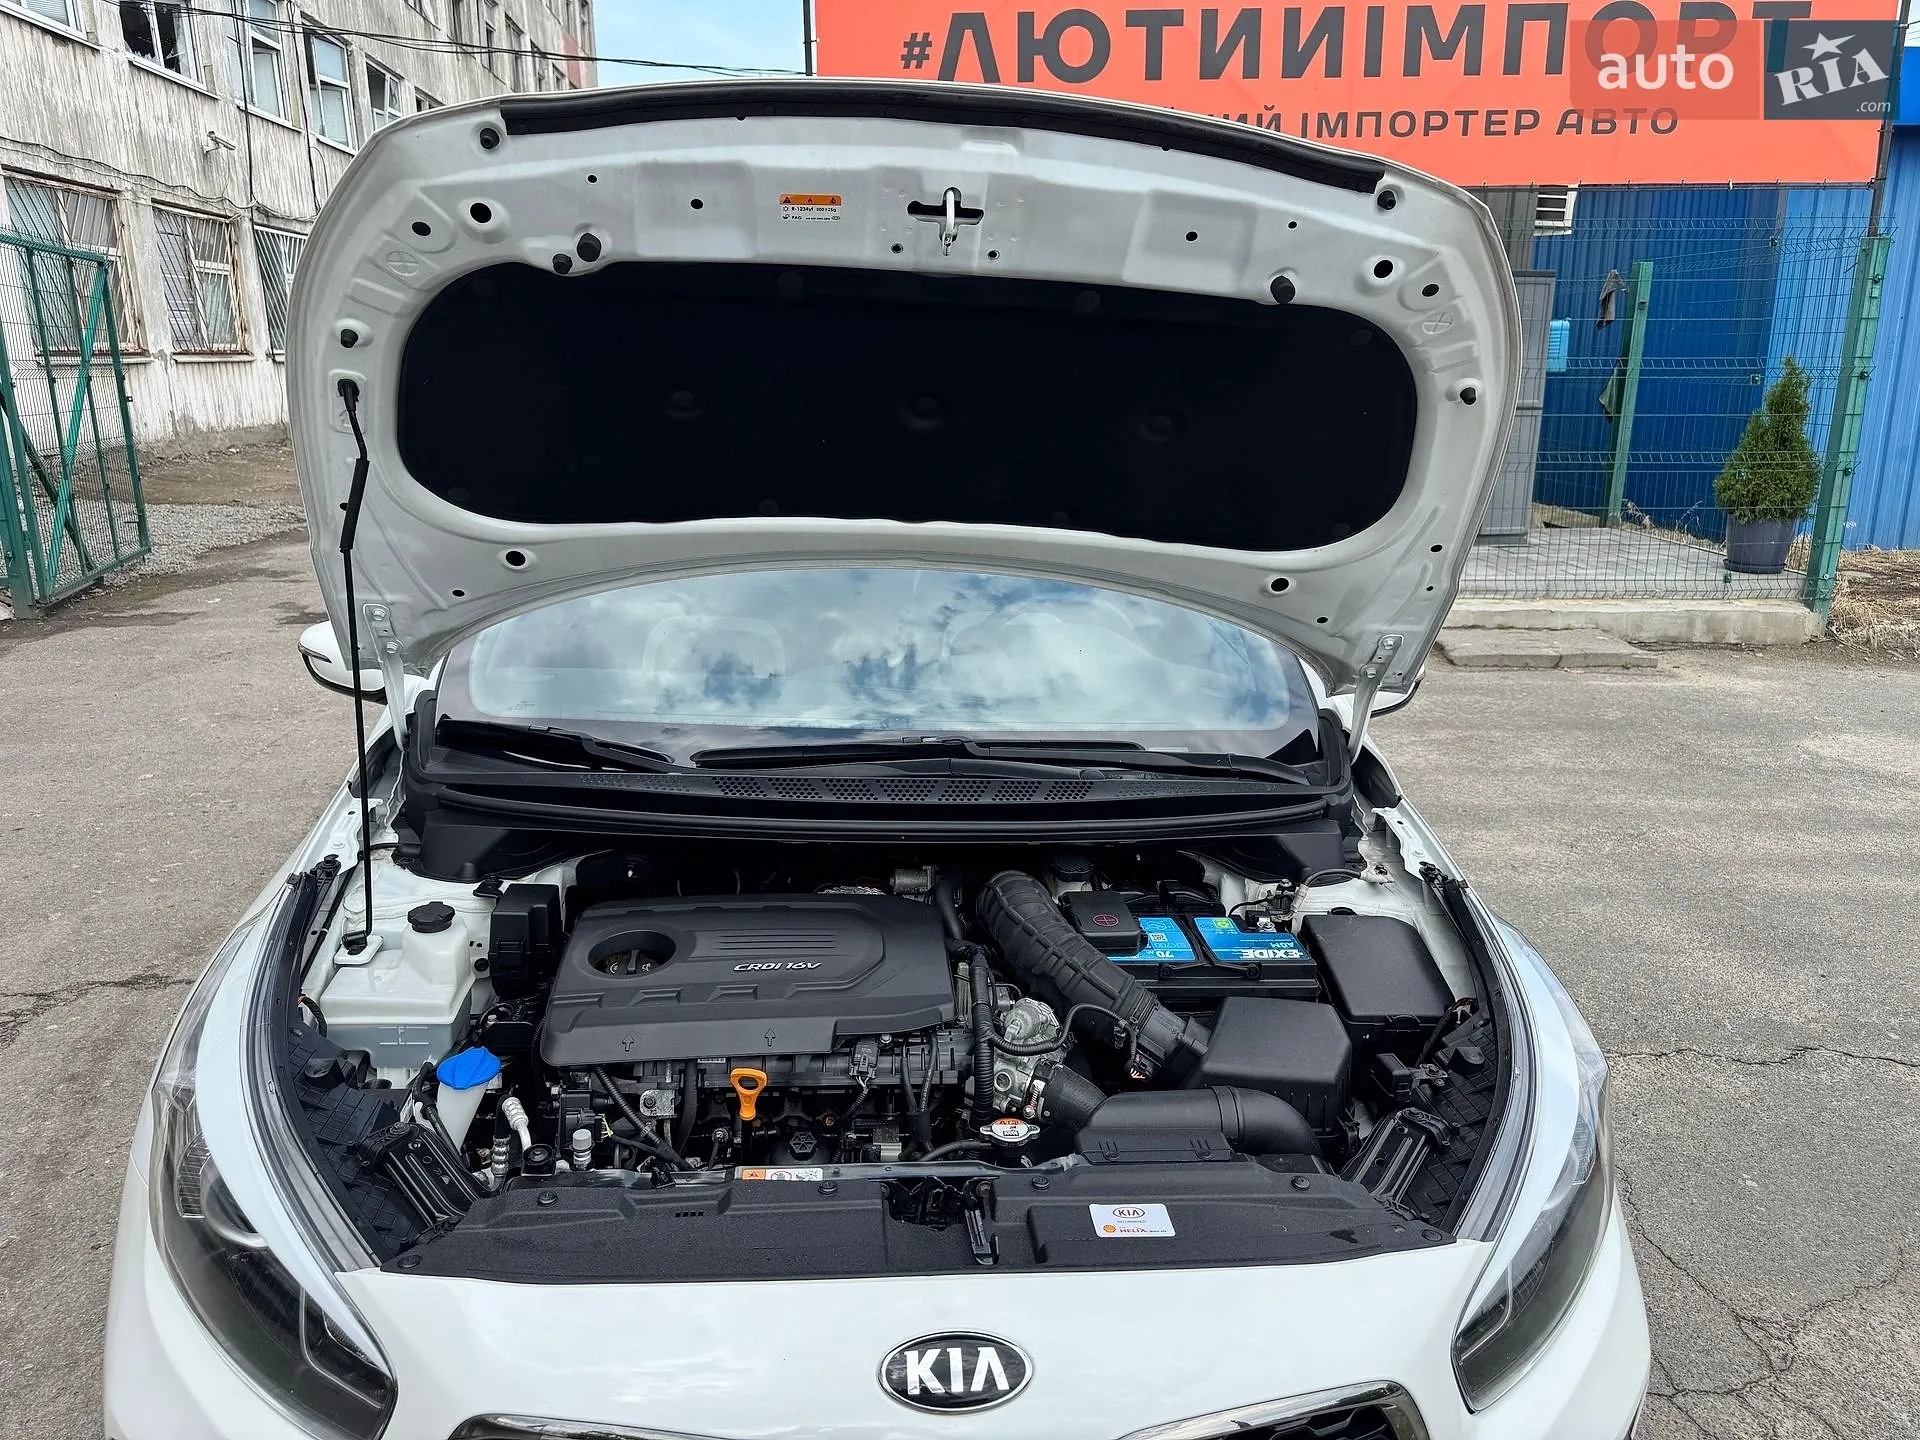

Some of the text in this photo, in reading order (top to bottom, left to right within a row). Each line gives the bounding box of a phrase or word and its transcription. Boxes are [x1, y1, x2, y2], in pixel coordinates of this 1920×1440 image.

[1301, 108, 1540, 139] ІМПОРТЕР
[1556, 107, 1679, 136] АВТО
[1242, 949, 1303, 959] EXIDE
[785, 960, 822, 970] 16V
[1117, 1209, 1140, 1217] KIA
[903, 1346, 1010, 1395] KIA
